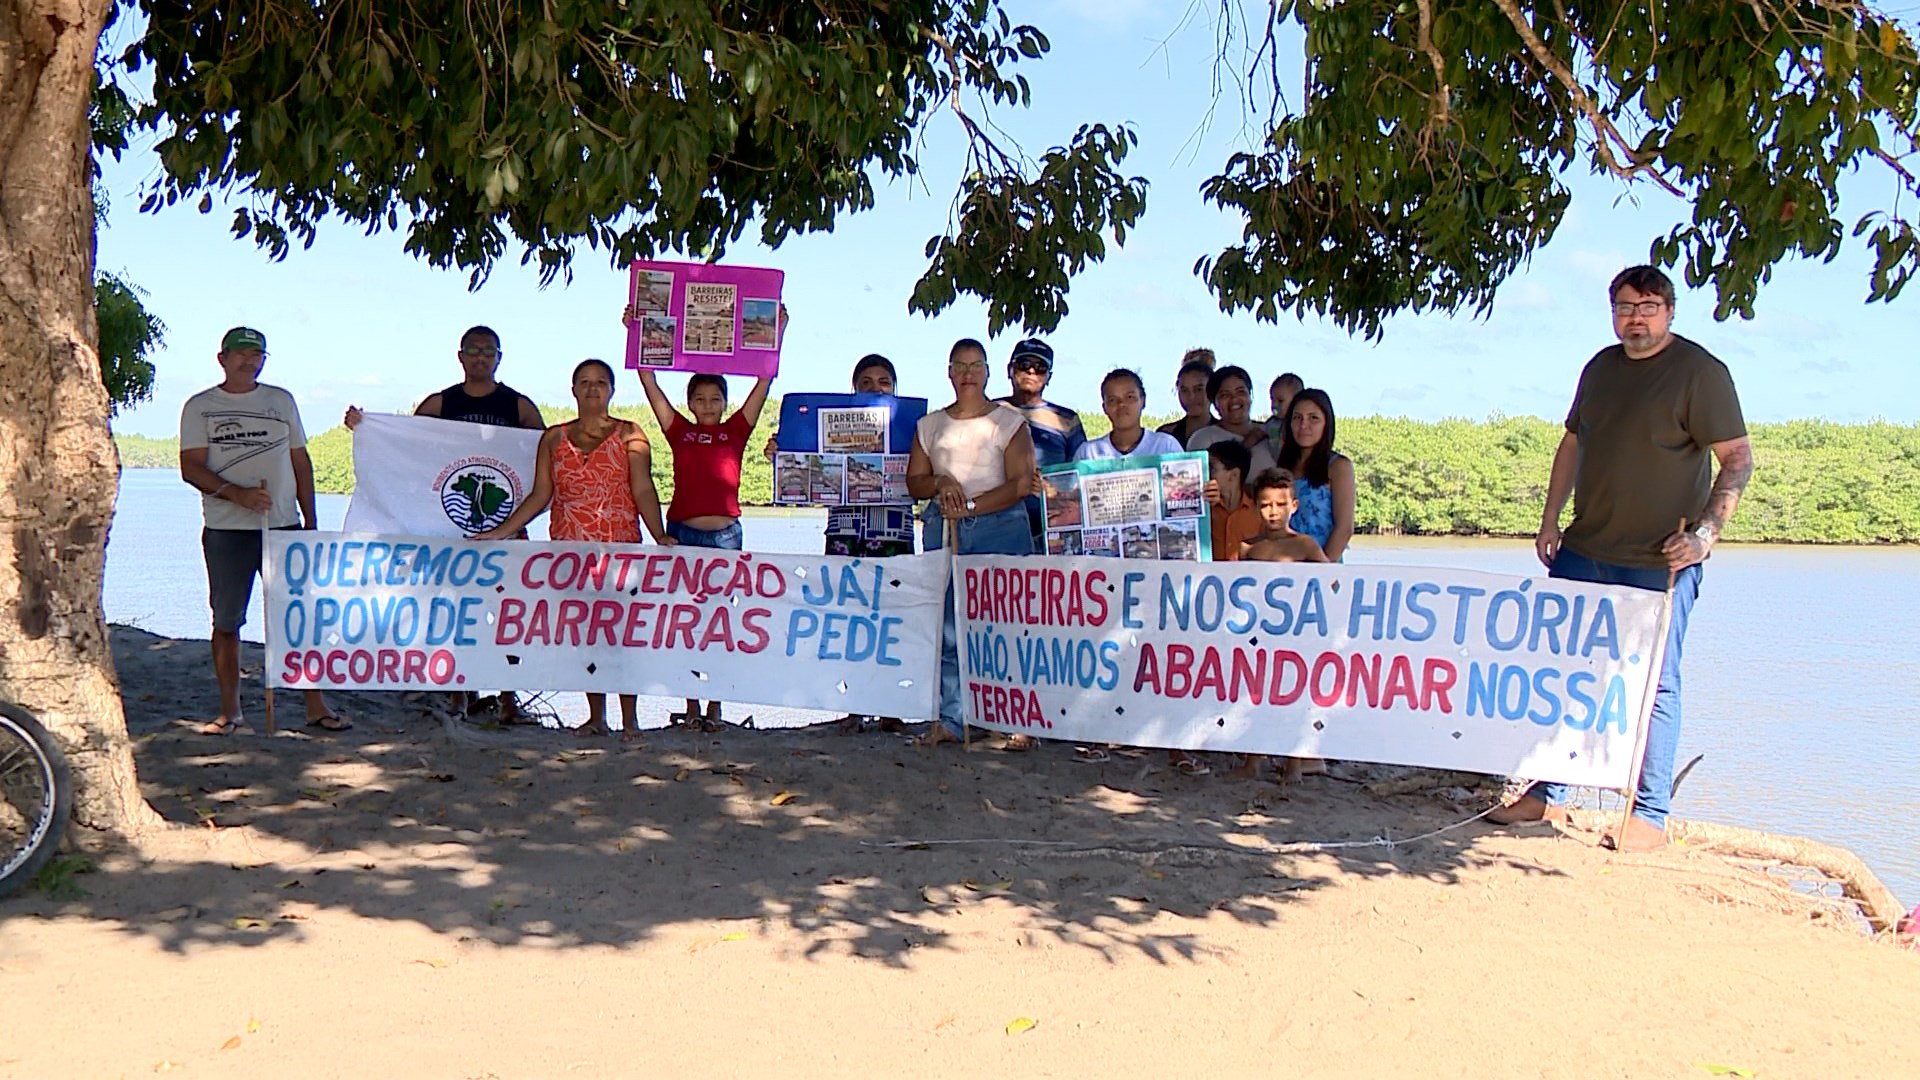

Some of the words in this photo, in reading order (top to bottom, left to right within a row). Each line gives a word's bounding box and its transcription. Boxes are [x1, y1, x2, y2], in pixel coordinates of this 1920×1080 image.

[690, 286, 733, 296] BARREIRAS
[827, 412, 878, 424] BARREIRAS
[285, 542, 508, 595] QUEREMOS
[521, 552, 787, 603] CONTENÇÃO
[802, 559, 884, 621] JÁ!
[965, 567, 1108, 627] BARREIRAS
[1122, 572, 1146, 629] E
[1158, 572, 1328, 636] NOSSA
[284, 598, 306, 648] O
[313, 597, 420, 647] POVO
[425, 597, 483, 646] DE
[495, 598, 772, 654] BARREIRAS
[785, 609, 904, 667] PEDE
[282, 649, 466, 685] SOCORRO.
[1016, 633, 1121, 691] VAMOS
[1132, 642, 1458, 714] ABANDONAR
[1466, 661, 1628, 735] NOSSA
[969, 681, 1053, 729] TERRA.
